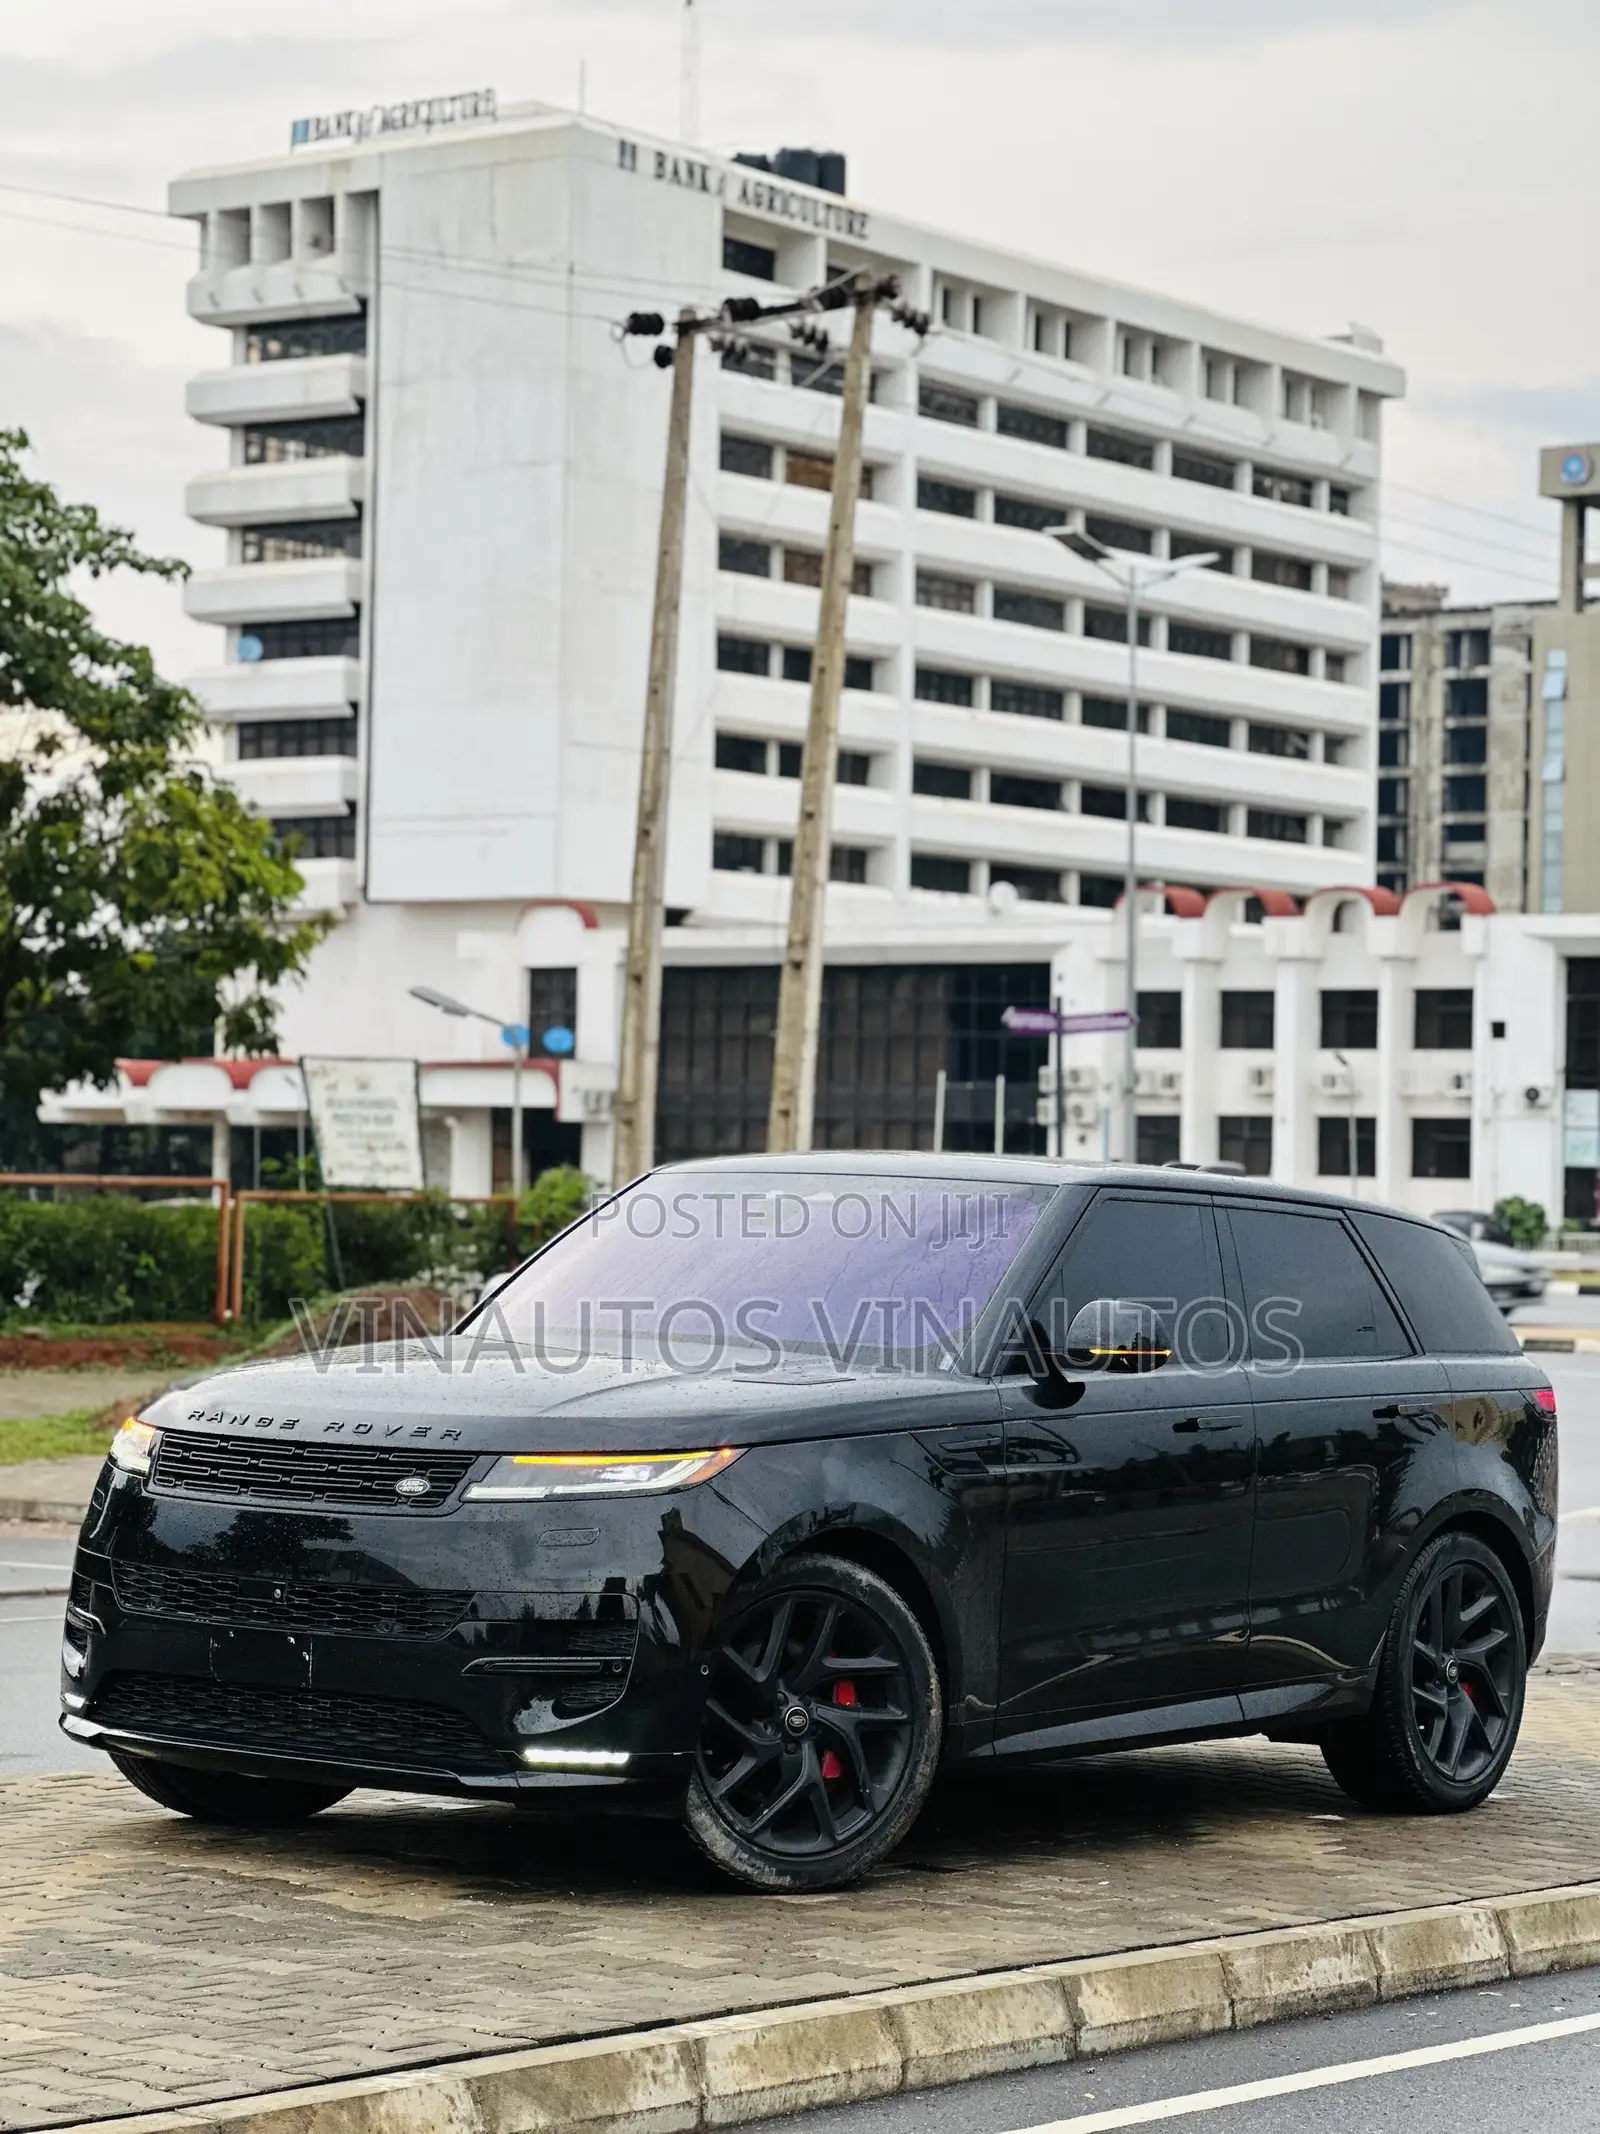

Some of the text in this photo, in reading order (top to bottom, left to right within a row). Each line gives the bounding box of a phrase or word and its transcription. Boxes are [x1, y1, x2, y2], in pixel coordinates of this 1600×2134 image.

[653, 151, 711, 192] BANK
[737, 178, 870, 239] AGRICULTURE
[187, 1409, 463, 1442] RANGE ROVER
